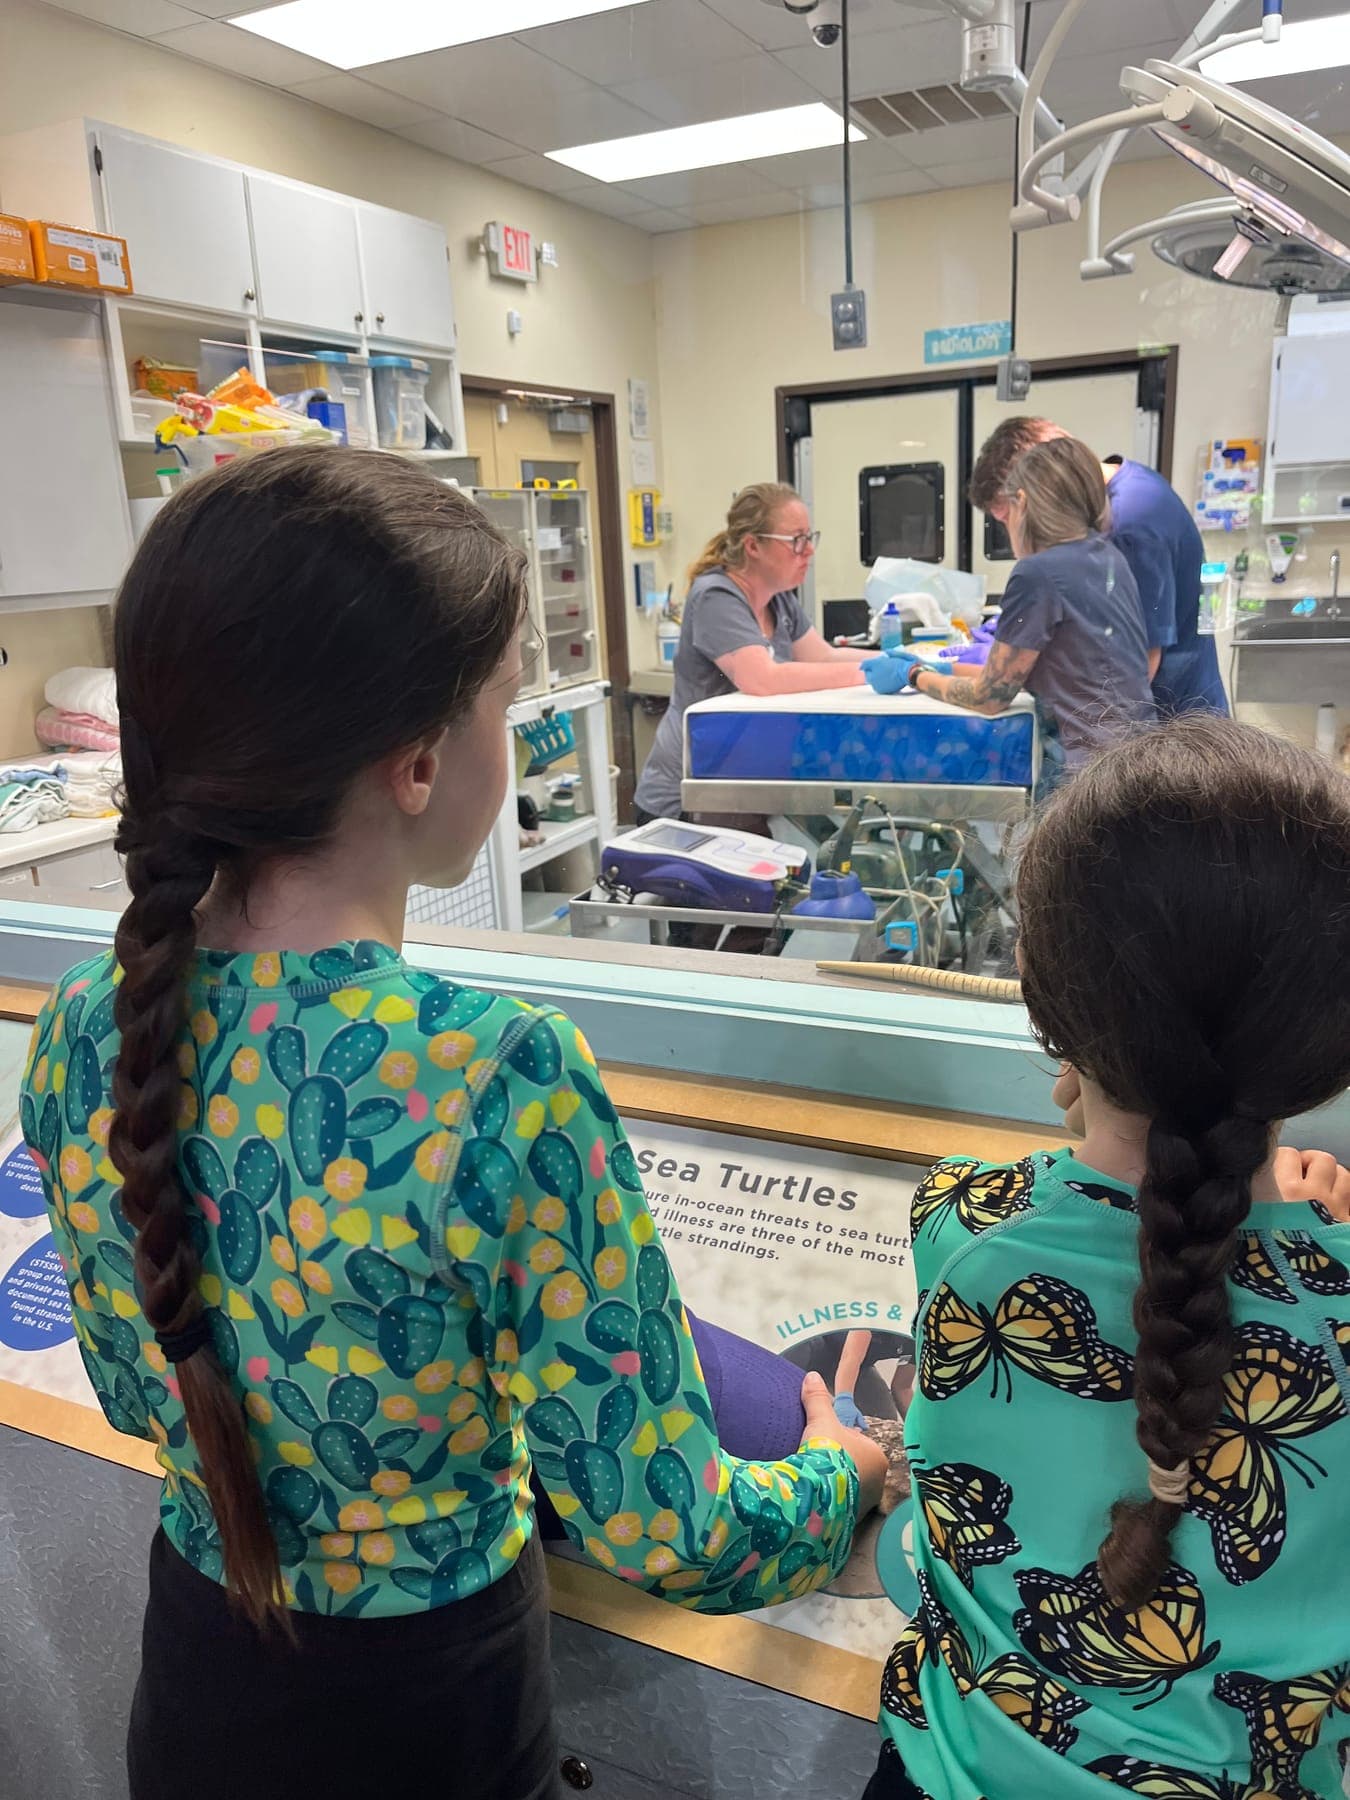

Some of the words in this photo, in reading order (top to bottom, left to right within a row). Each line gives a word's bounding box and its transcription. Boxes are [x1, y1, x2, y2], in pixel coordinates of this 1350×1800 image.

[503, 225, 532, 273] EXIT
[7, 1160, 40, 1173] conserva
[636, 1149, 701, 1183] Sea
[719, 1163, 858, 1211] Turtles
[675, 1194, 744, 1217] in-ocean
[750, 1208, 810, 1229] threats
[816, 1221, 833, 1234] to
[839, 1227, 869, 1241] sea
[664, 1208, 714, 1229] illness
[719, 1222, 746, 1235] are
[751, 1226, 796, 1245] three
[802, 1238, 821, 1250] of
[826, 1240, 854, 1256] the
[860, 1249, 905, 1267] most
[687, 1233, 780, 1260] strandings.
[18, 1268, 43, 1280] group
[43, 1273, 55, 1282] of
[30, 1258, 64, 1273] (STSSN)
[8, 1287, 48, 1305] document
[47, 1300, 63, 1309] sea
[22, 1280, 53, 1294] private
[11, 1300, 37, 1314] found
[36, 1307, 73, 1324] stranded
[775, 1301, 879, 1339] ILLNESS
[886, 1304, 903, 1321] &
